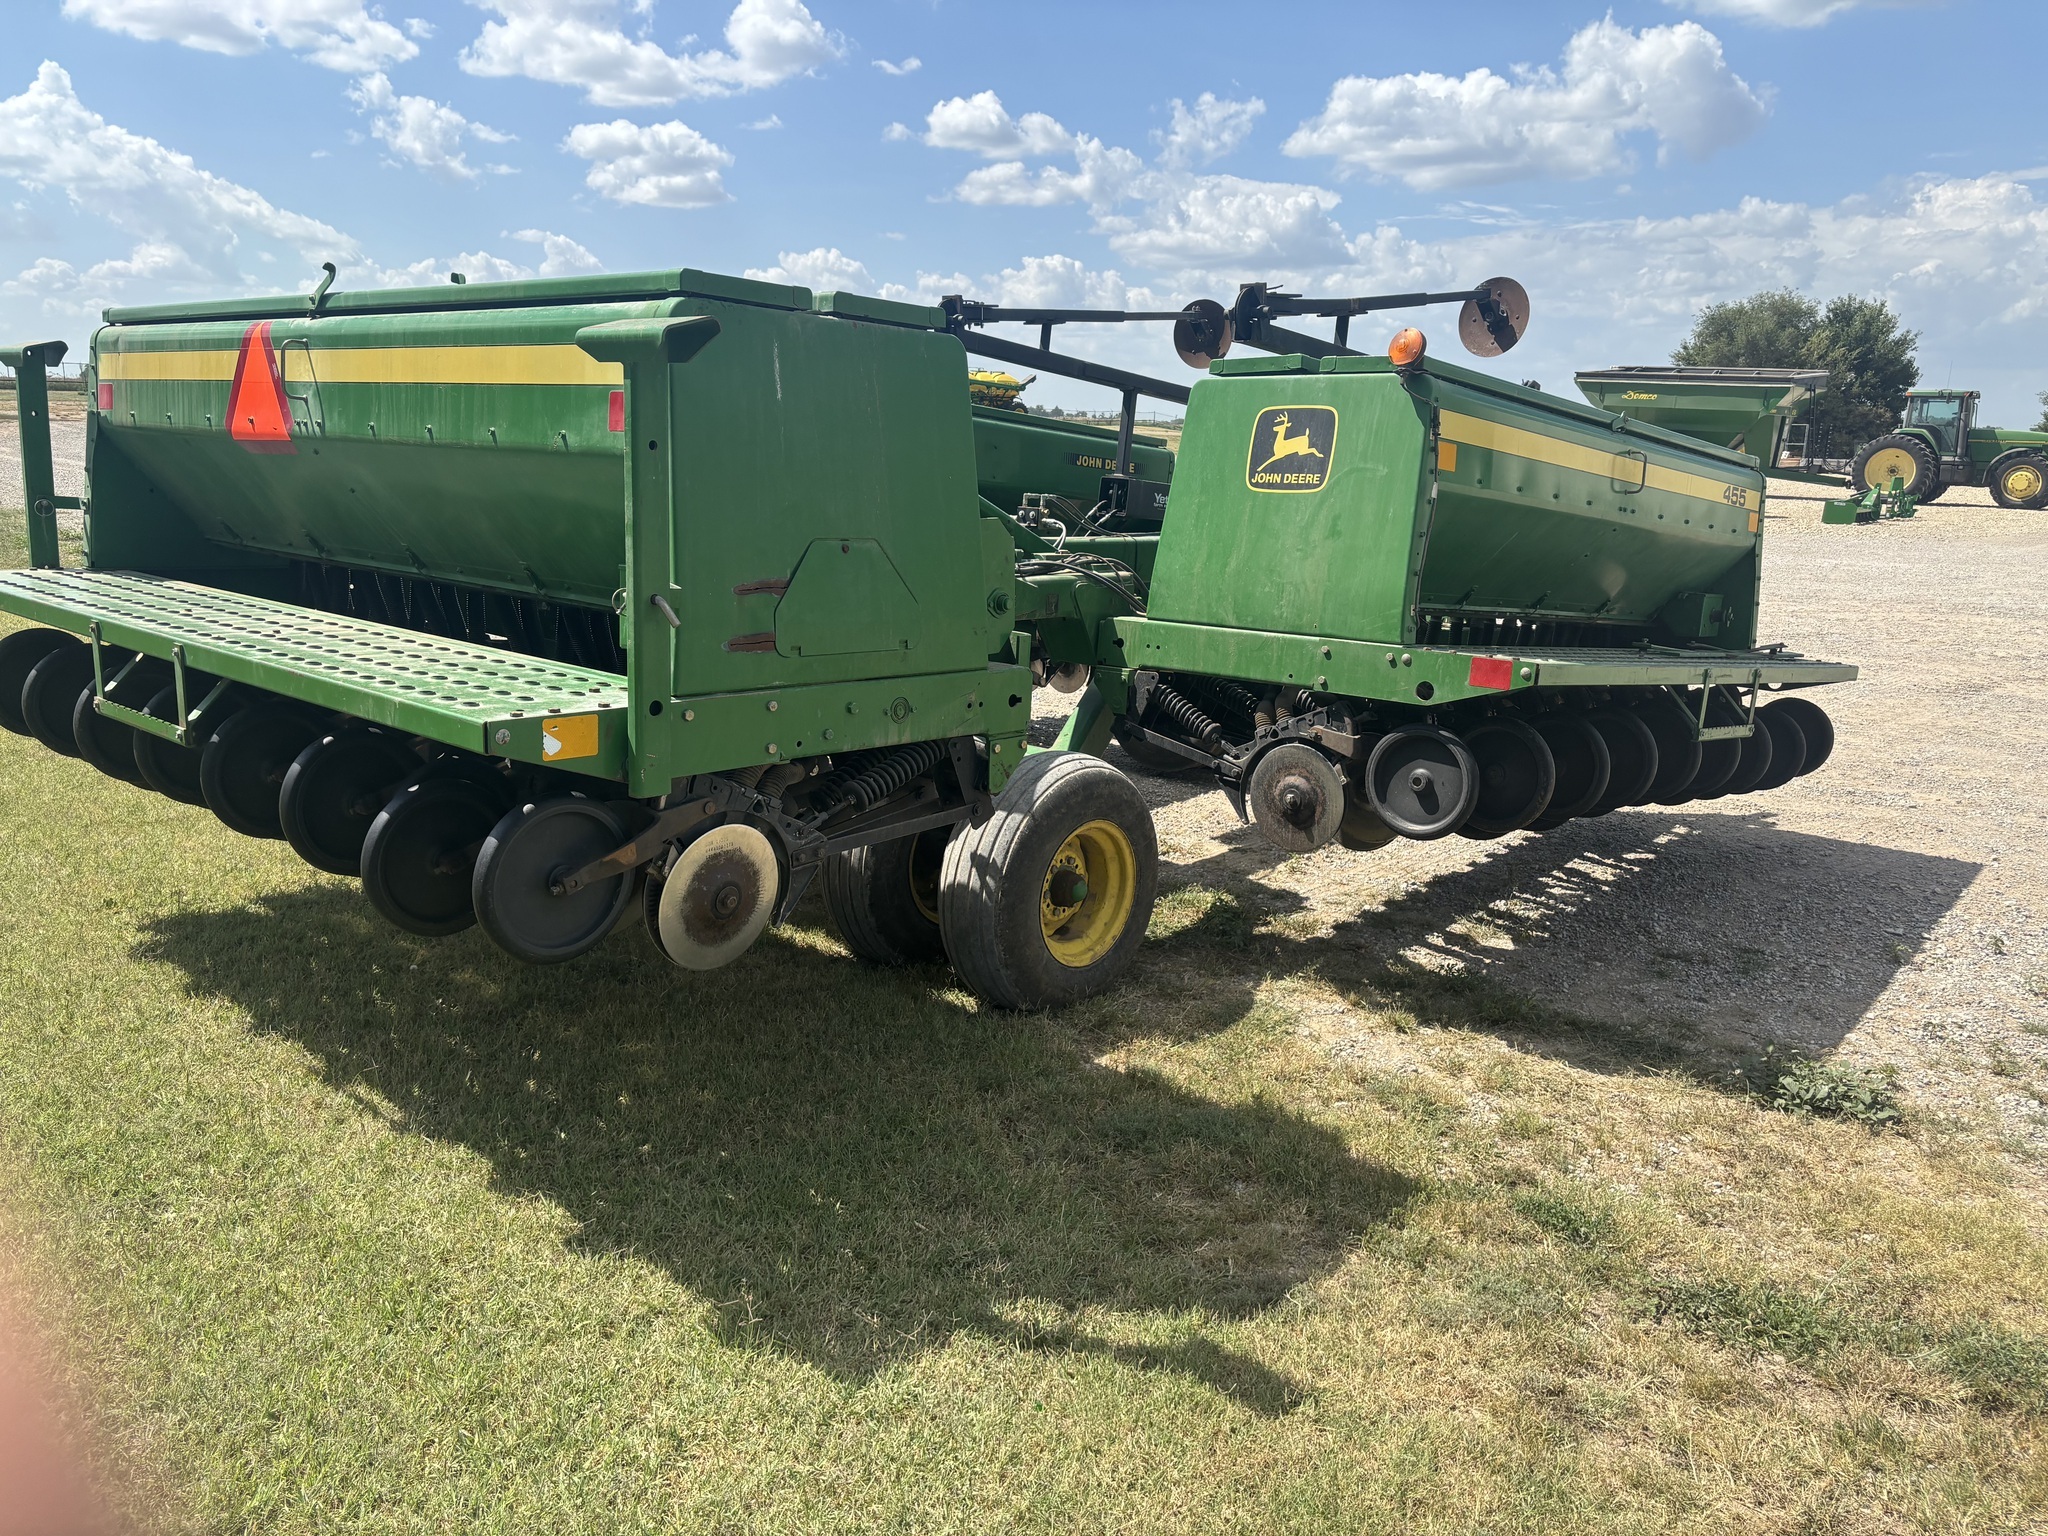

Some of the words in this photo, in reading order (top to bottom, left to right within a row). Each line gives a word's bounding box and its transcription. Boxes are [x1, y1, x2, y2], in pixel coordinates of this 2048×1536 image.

[1076, 455, 1102, 469] JOHN
[1105, 459, 1135, 473] DEE
[1251, 473, 1282, 484] JOHN
[1283, 473, 1321, 484] DEERE
[1722, 485, 1747, 507] 455
